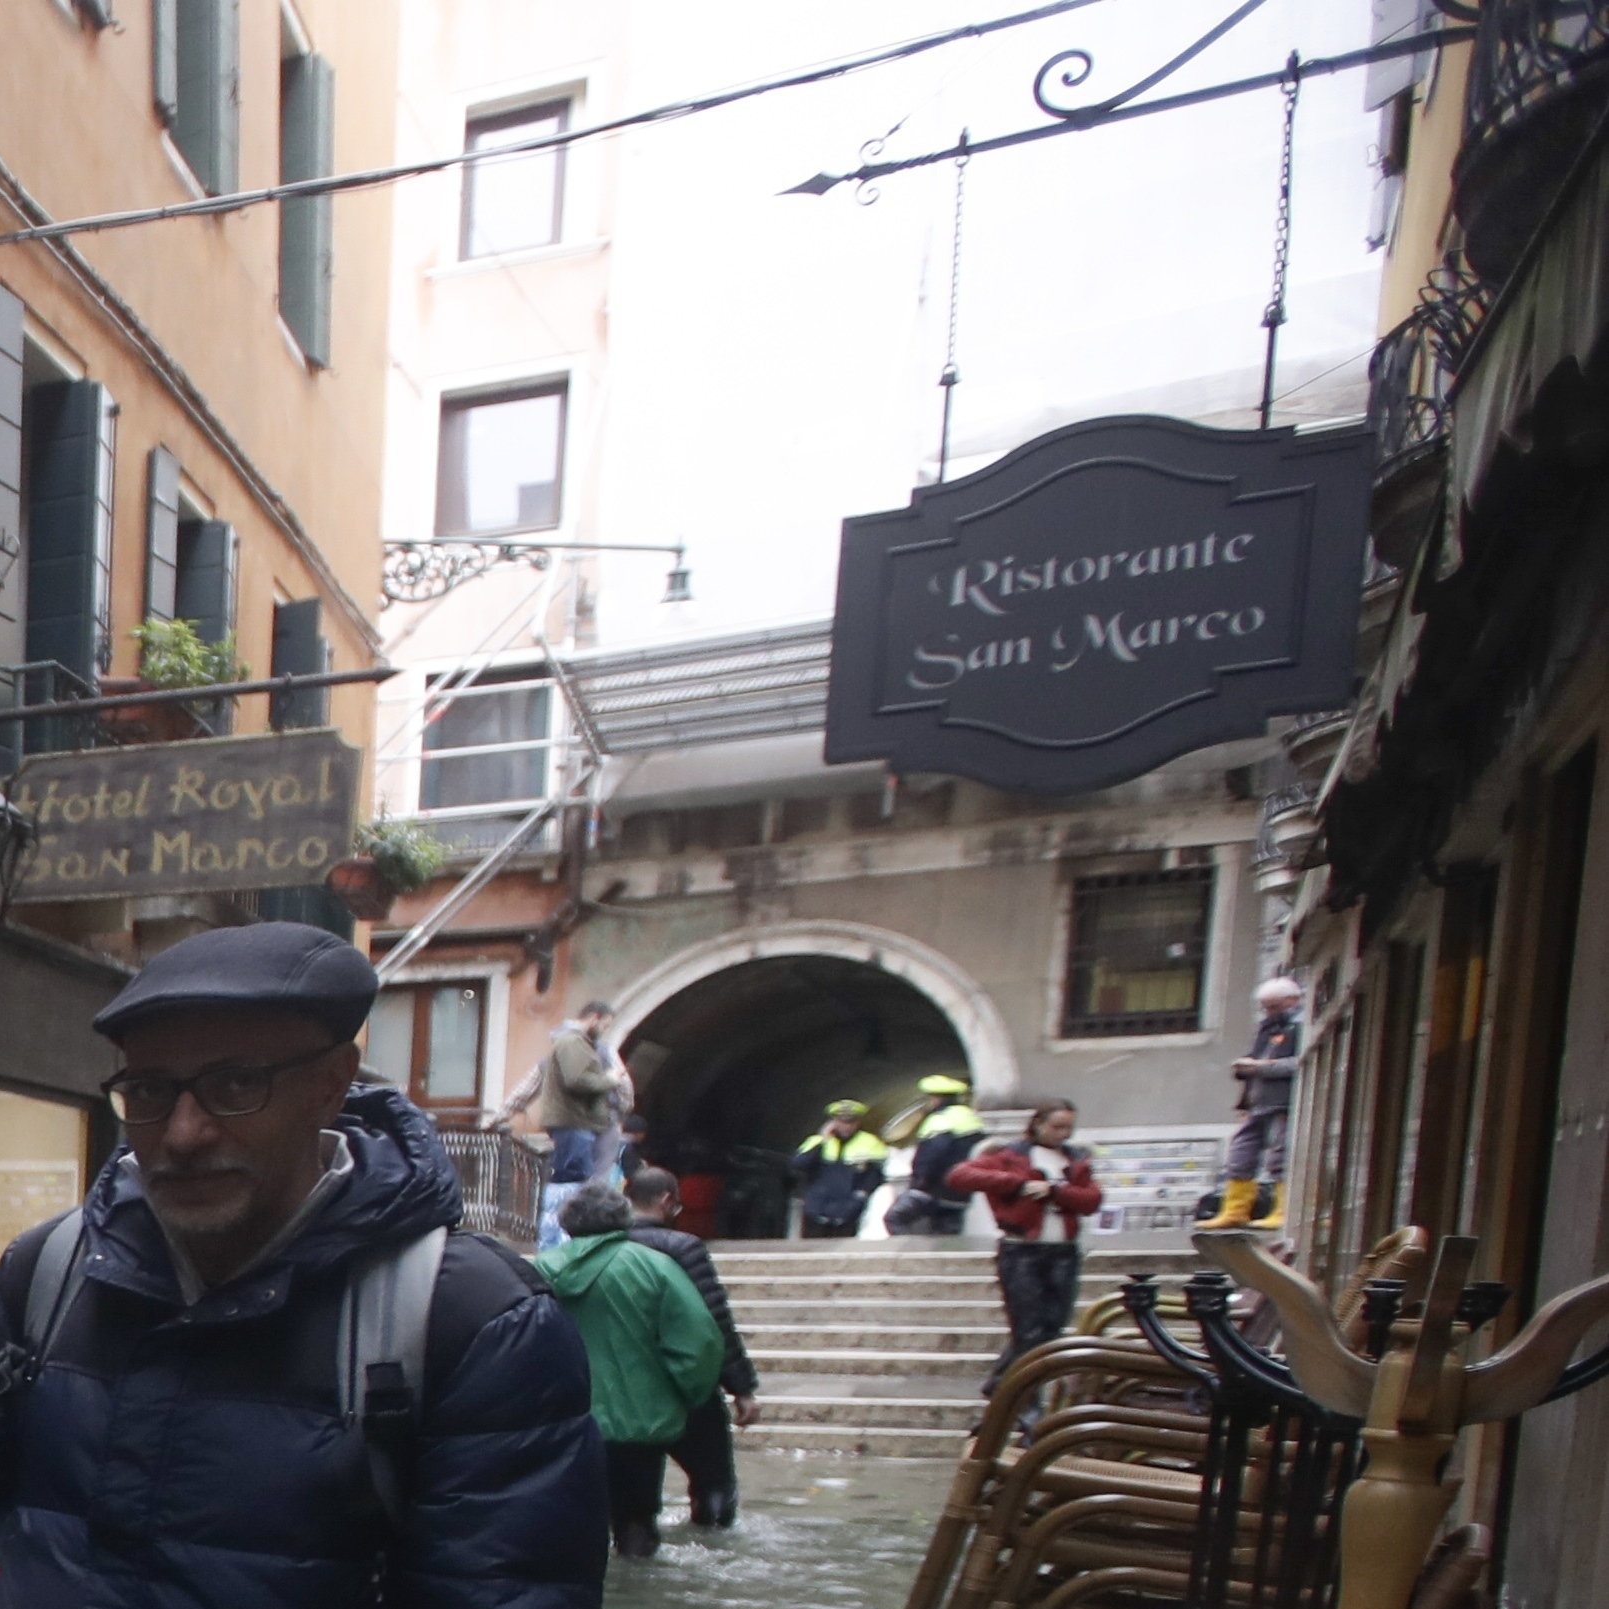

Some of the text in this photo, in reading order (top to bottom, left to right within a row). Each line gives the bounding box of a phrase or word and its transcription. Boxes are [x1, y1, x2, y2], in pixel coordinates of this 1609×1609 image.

[927, 530, 1257, 617] Ristorante
[905, 604, 1267, 691] San Marco
[1, 755, 333, 826] Hotel Royal
[149, 828, 332, 877] Marco
